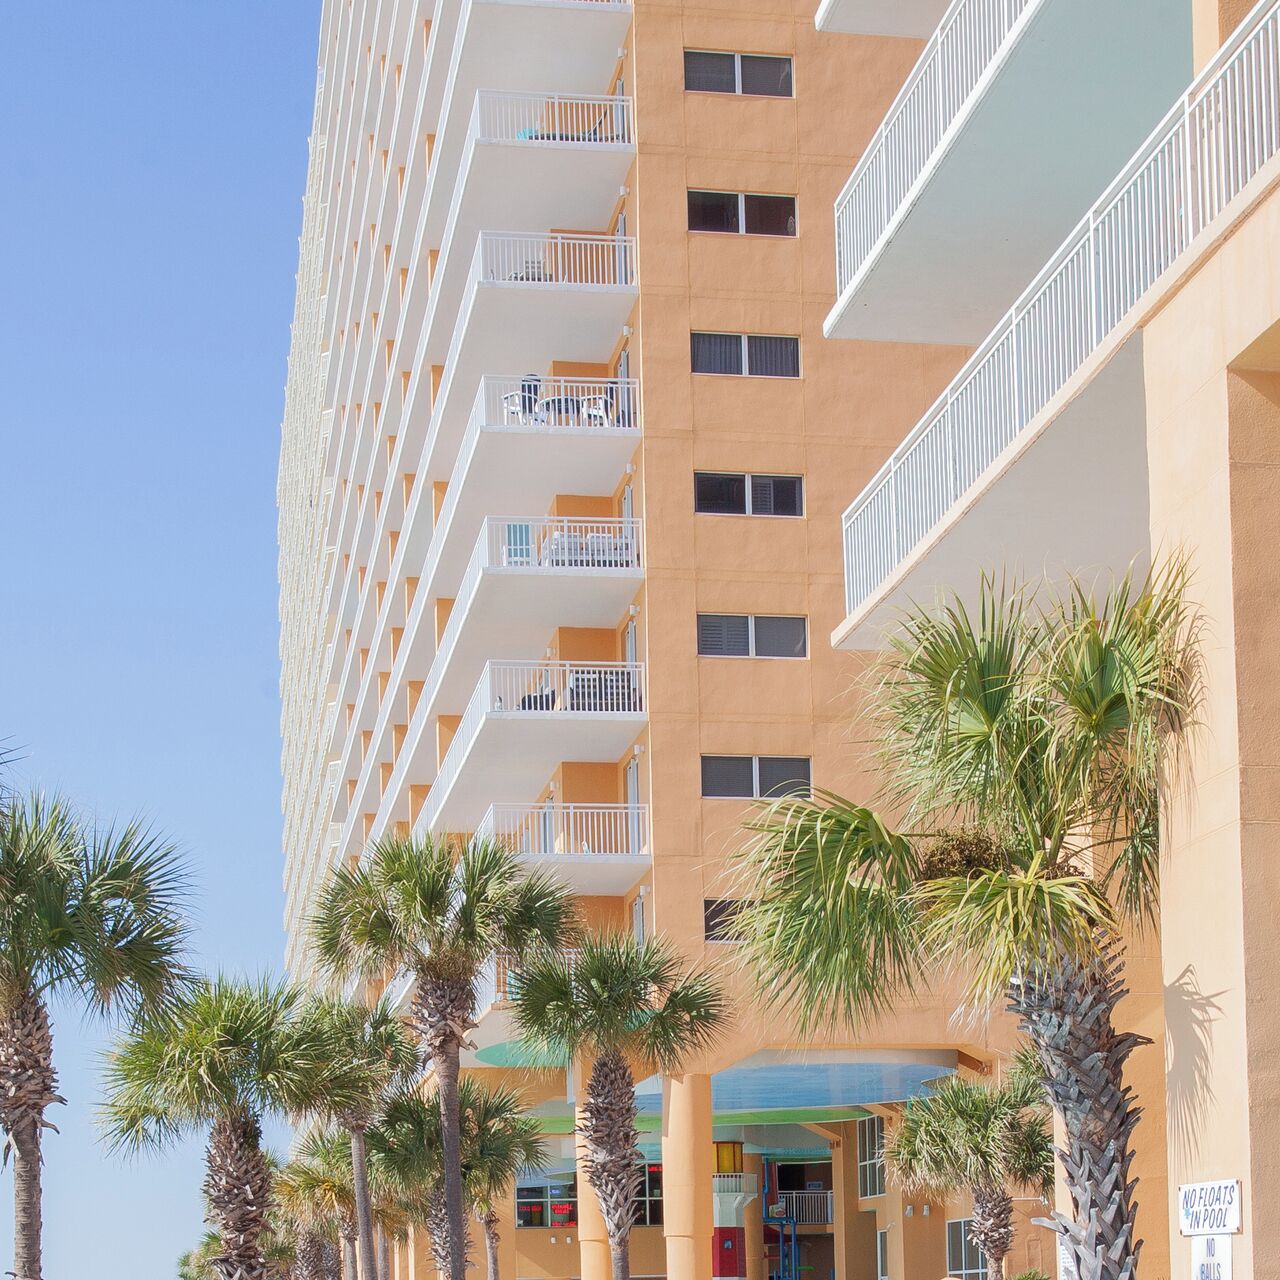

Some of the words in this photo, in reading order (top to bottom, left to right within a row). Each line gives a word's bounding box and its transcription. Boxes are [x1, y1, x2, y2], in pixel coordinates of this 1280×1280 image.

[1182, 1188, 1197, 1209] NO
[1198, 1184, 1235, 1207] FLOATS
[1190, 1210, 1201, 1230] IN
[1202, 1208, 1228, 1229] POOL
[1206, 1237, 1215, 1258] NO
